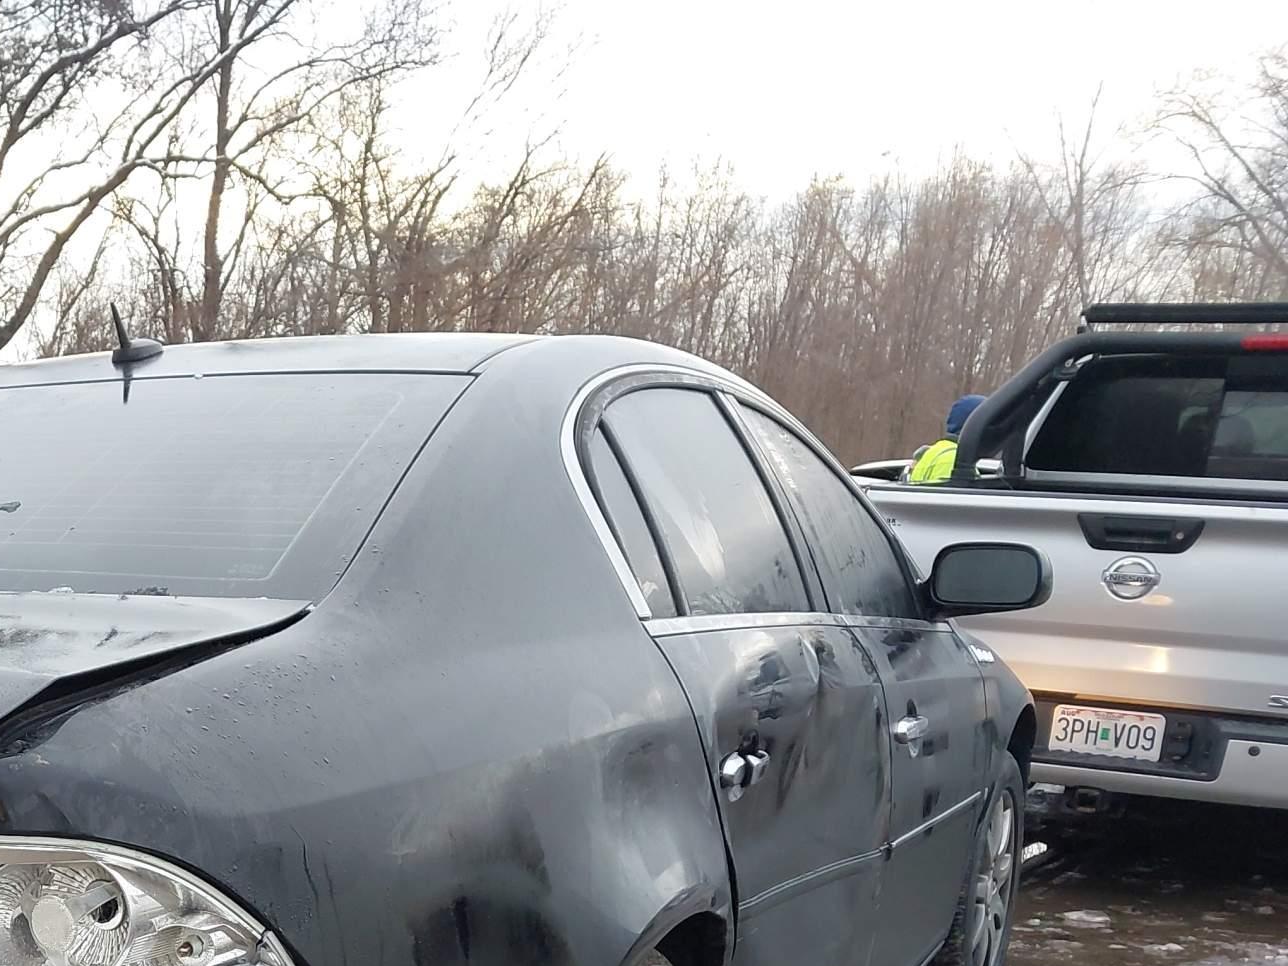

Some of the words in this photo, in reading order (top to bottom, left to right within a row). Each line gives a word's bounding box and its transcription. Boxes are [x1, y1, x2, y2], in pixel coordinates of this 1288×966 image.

[1109, 573, 1152, 583] NISSAN
[1055, 717, 1100, 746] 3PH
[1114, 722, 1156, 751] V09
